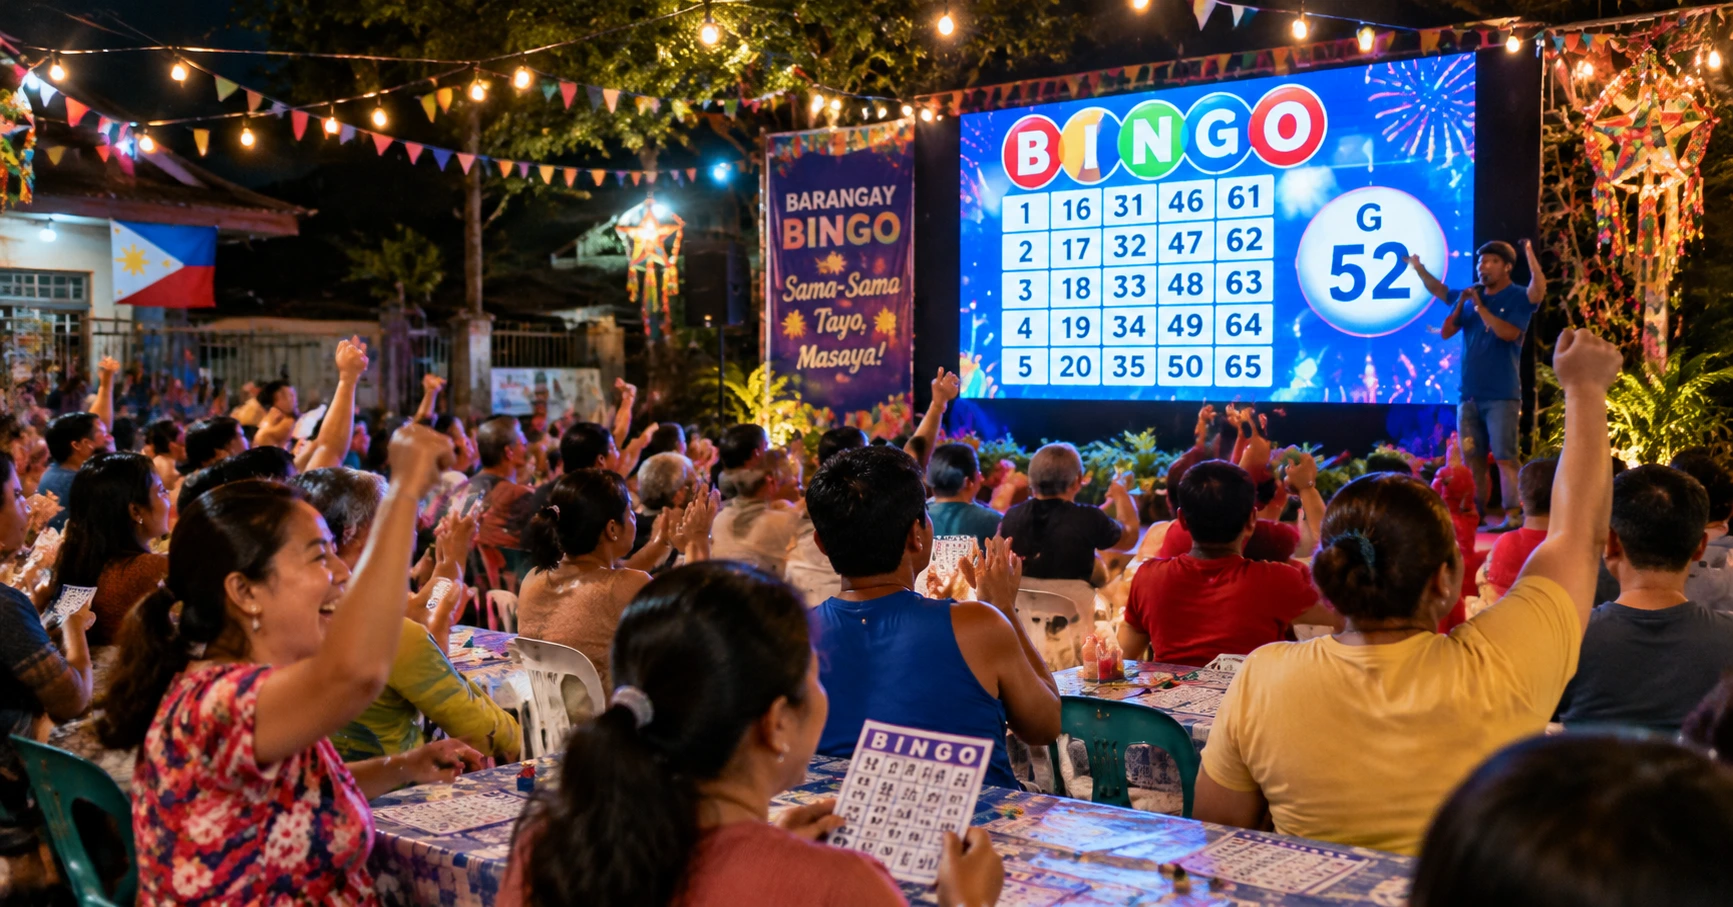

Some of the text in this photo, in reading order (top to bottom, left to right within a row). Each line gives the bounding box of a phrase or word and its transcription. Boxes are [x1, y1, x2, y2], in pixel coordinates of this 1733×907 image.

[1017, 101, 1311, 176] BINGO
[785, 186, 896, 211] BARANGAY
[1021, 184, 1259, 224] 1 16 31 46 61
[783, 212, 900, 249] BINGO
[1356, 203, 1381, 232] G
[1019, 227, 1262, 262] 2 17 32 47 62
[782, 272, 901, 302] Sama-Sama
[1019, 270, 1262, 301] 3 18 33 48 63
[1330, 242, 1411, 302] 52
[1018, 313, 1262, 339] 4 19 34 49 64
[796, 342, 886, 374] Masaya!
[1019, 355, 1261, 378] 5 20 35 50 65
[871, 732, 977, 764] BINGO
